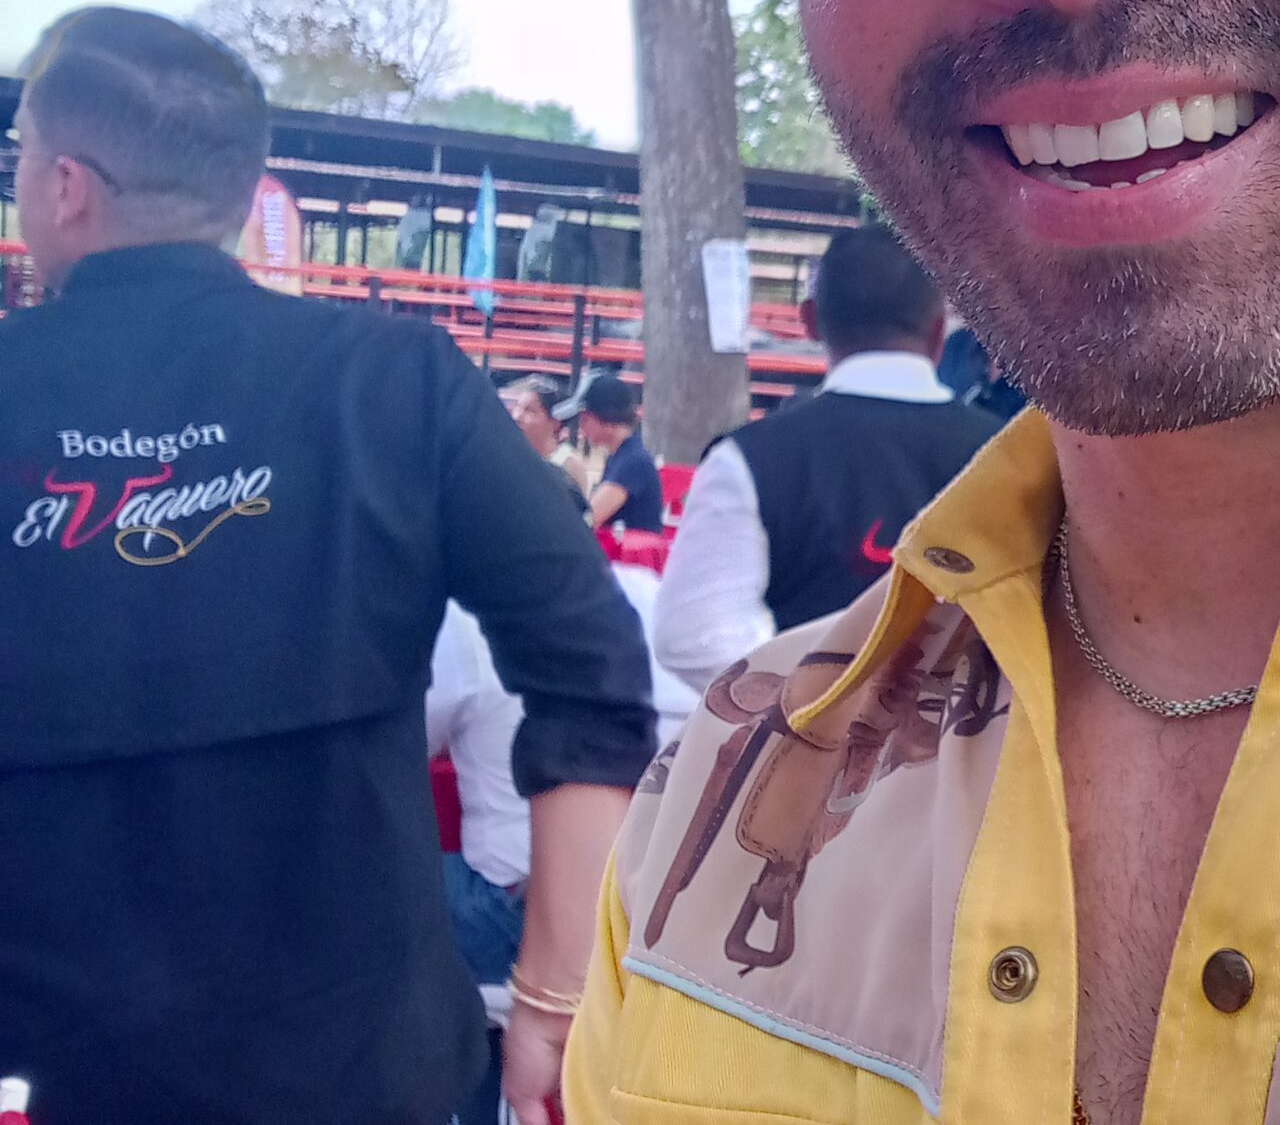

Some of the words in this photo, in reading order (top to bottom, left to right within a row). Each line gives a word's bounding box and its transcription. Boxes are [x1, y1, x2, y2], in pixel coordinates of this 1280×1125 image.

[57, 422, 227, 463] Bodegón
[12, 495, 70, 548] El
[44, 464, 272, 553] Vaquero
